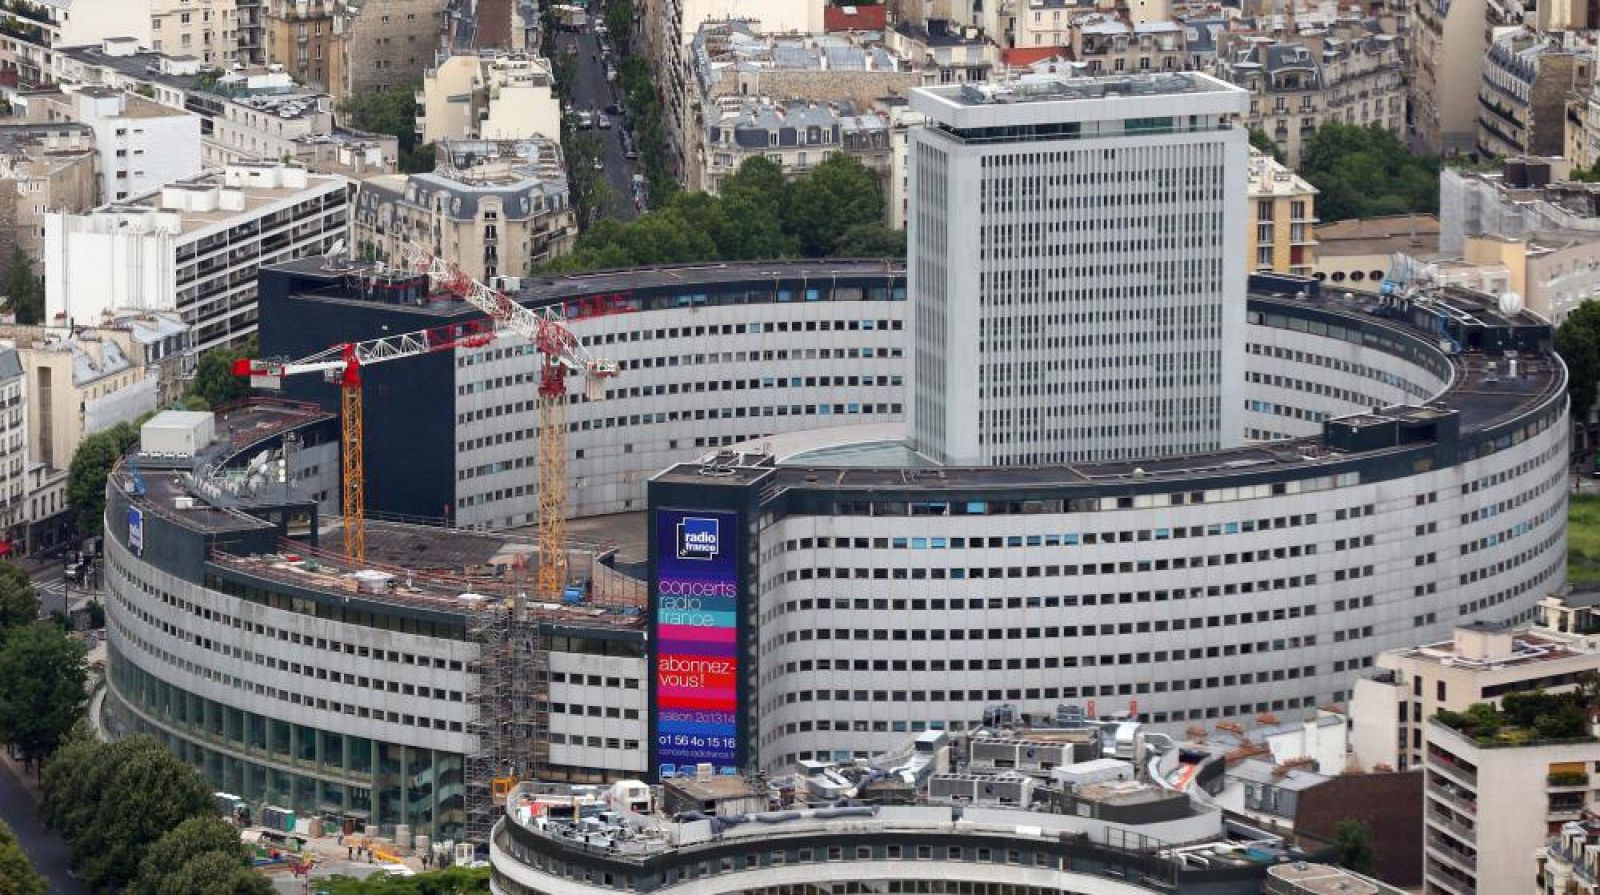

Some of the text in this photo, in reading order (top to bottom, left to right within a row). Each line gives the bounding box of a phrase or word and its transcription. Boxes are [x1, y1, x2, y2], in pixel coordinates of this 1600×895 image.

[685, 531, 716, 544] radio
[685, 542, 716, 552] france
[659, 580, 737, 598] concerts
[660, 594, 702, 611] radio
[660, 609, 714, 627] france
[660, 655, 737, 675] abonnez-
[659, 673, 705, 688] vous!
[674, 734, 689, 746] 56
[706, 737, 720, 748] 15
